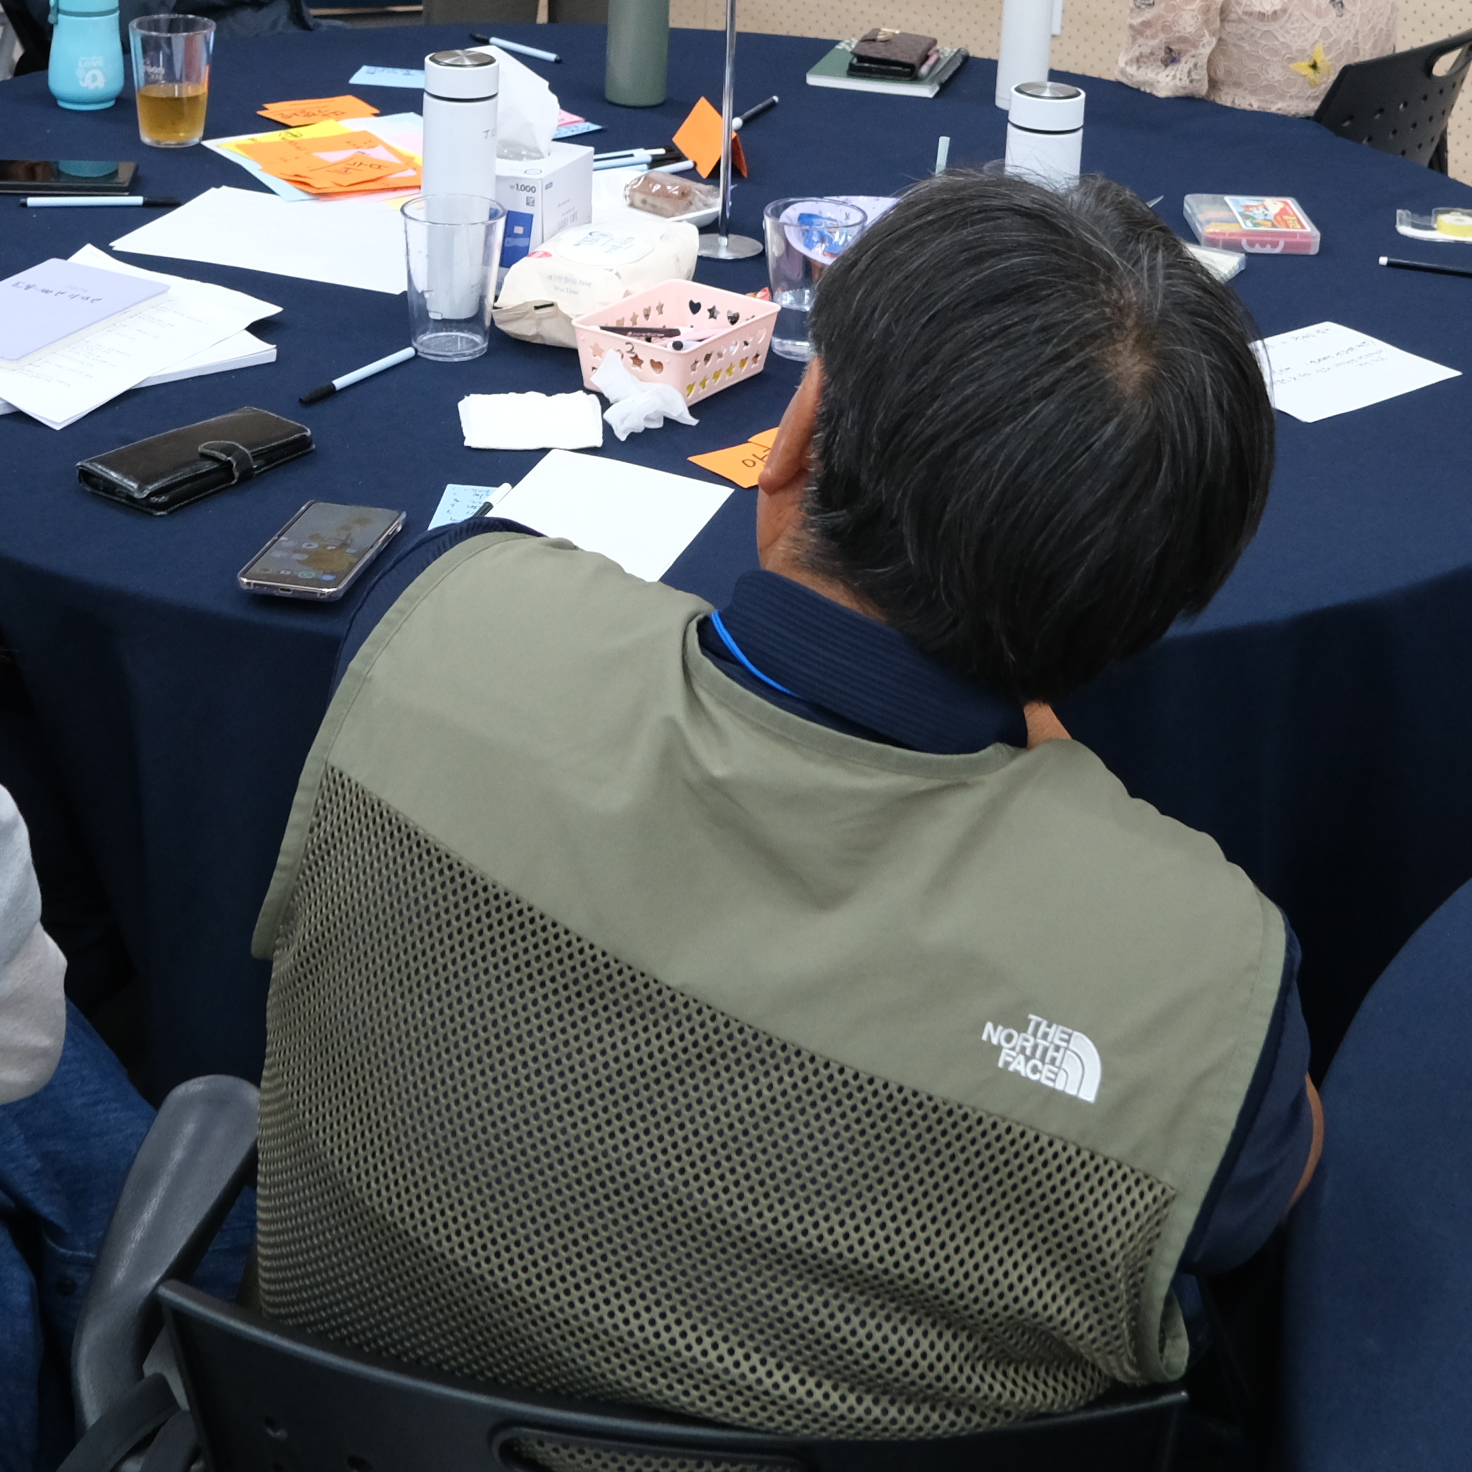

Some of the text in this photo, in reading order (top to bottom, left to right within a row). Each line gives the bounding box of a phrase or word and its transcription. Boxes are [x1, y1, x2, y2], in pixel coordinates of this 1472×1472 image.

[982, 1021, 1066, 1066] NORTH
[1025, 1014, 1074, 1048] THE
[998, 1048, 1058, 1087] FACE
